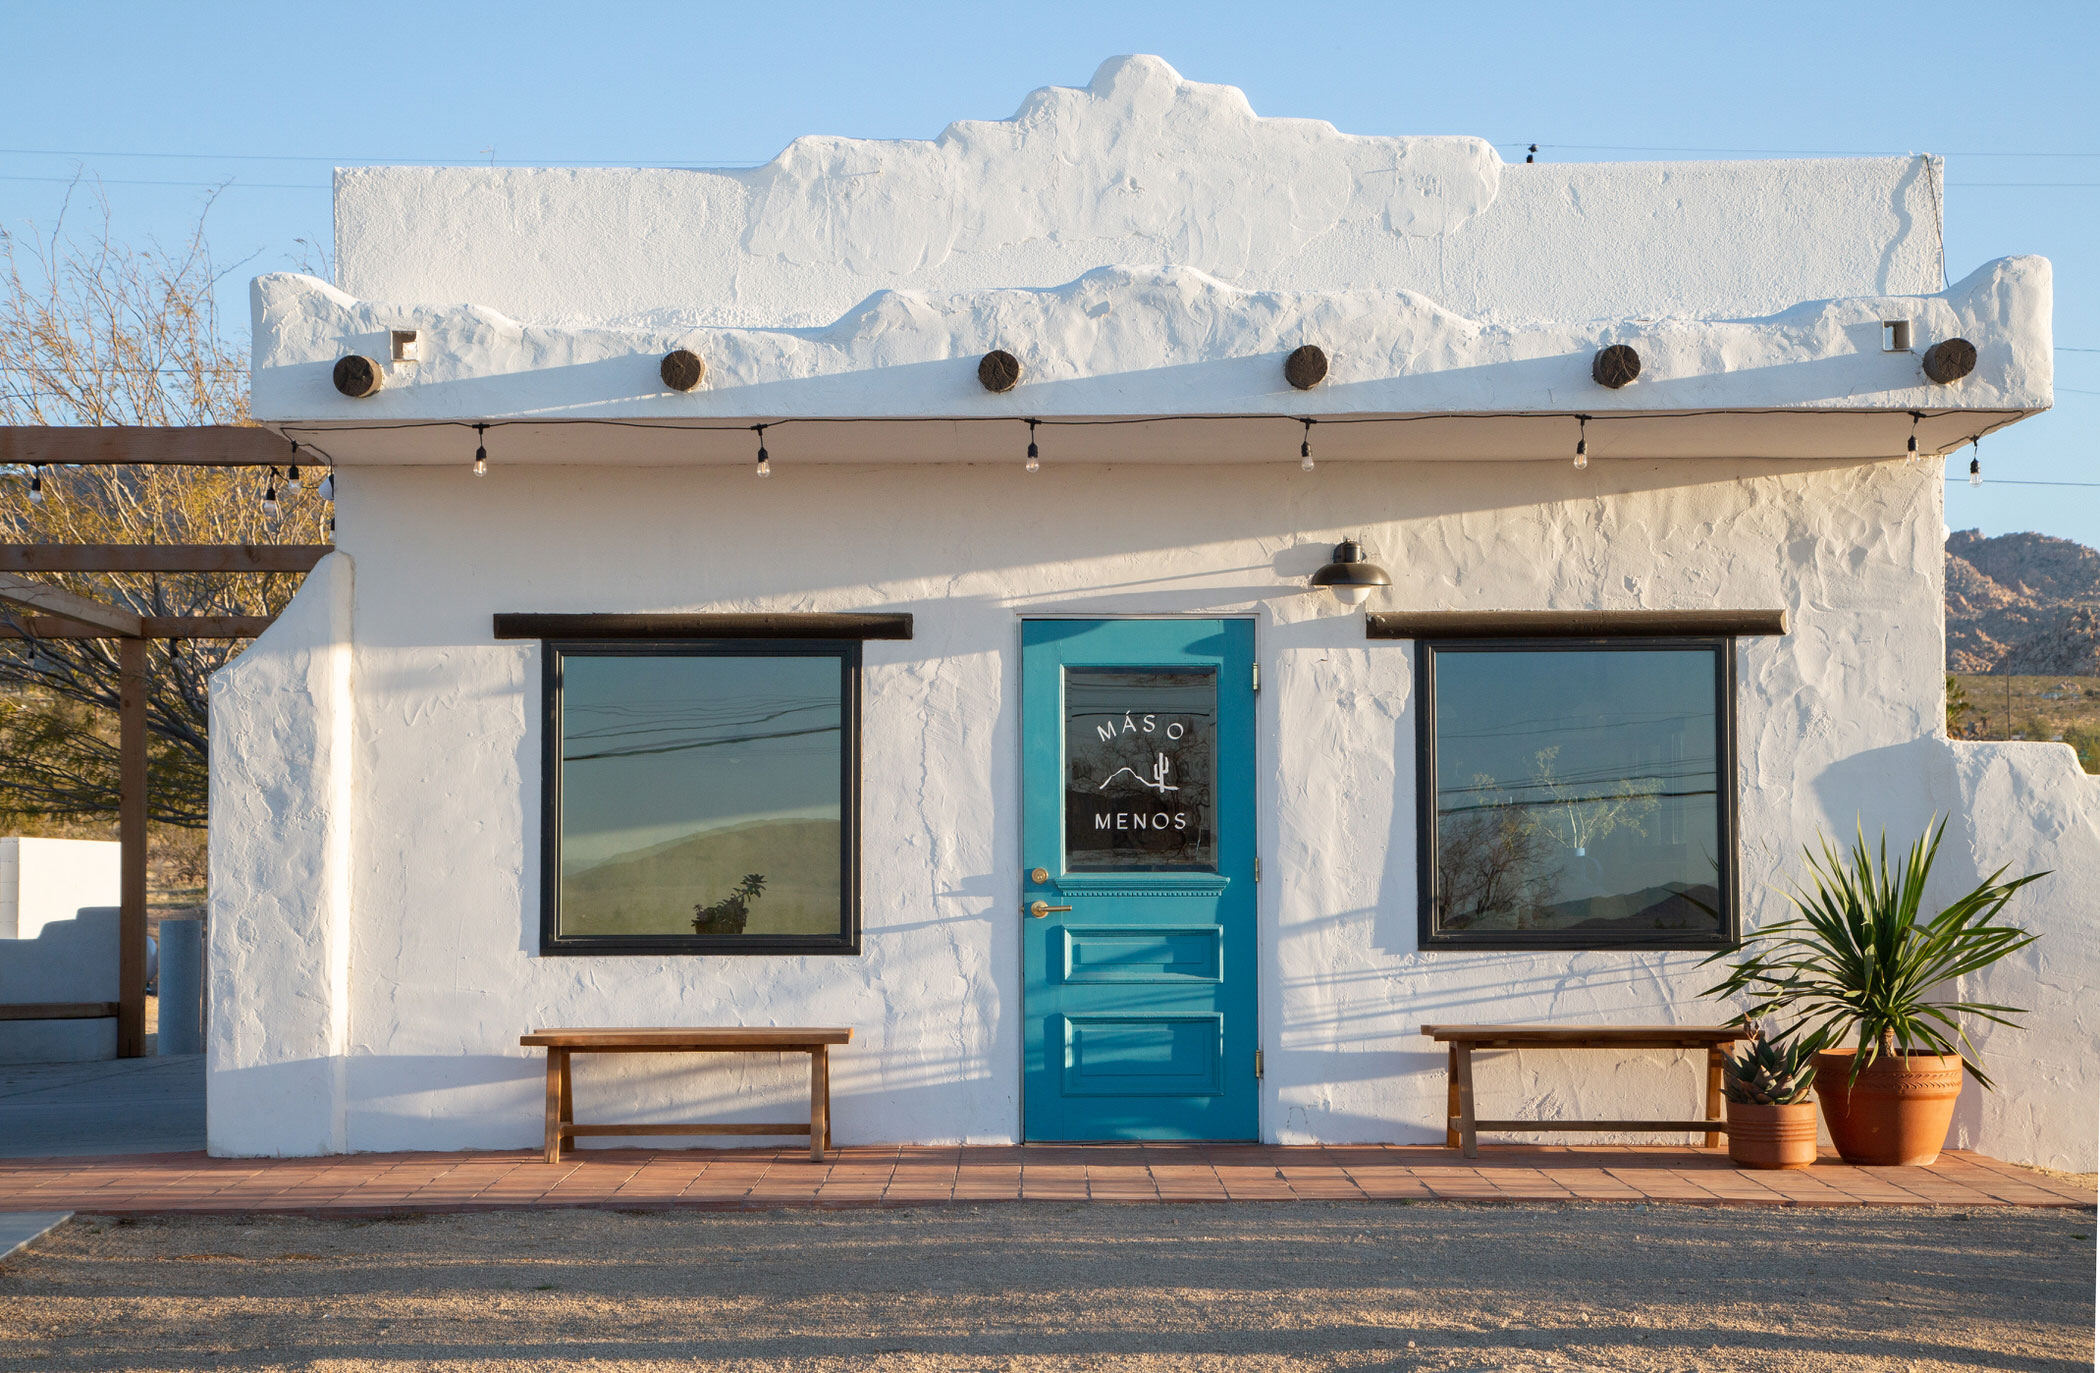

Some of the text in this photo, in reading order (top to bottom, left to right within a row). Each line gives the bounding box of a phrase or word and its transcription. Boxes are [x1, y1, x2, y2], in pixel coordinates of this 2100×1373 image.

[1096, 709, 1184, 742] MÁS O
[1095, 812, 1186, 830] MENOS
